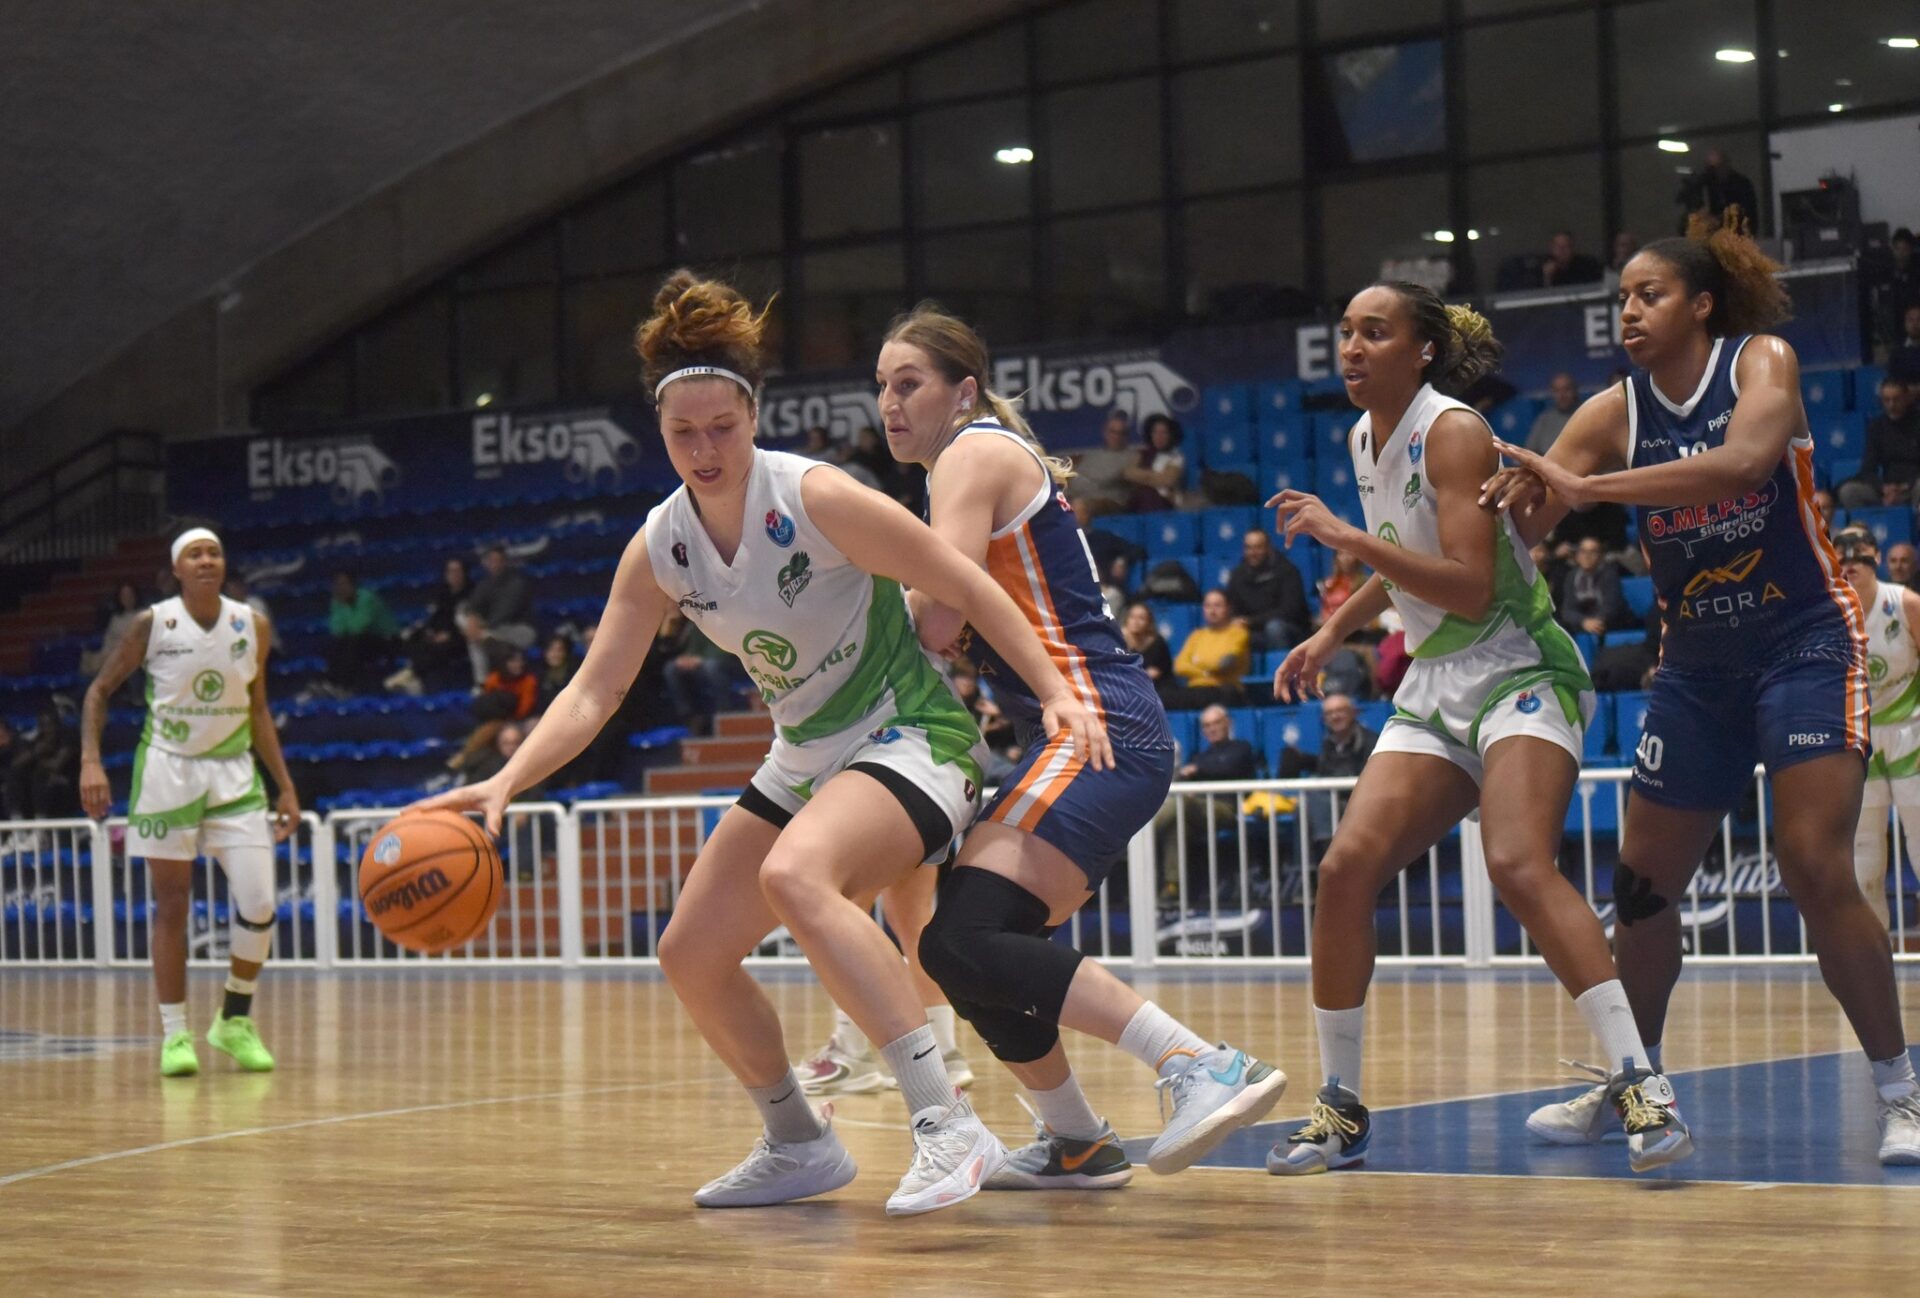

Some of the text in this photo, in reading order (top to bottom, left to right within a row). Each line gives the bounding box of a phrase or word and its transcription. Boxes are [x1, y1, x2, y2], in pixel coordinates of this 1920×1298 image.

[994, 357, 1113, 411] Ekso
[757, 388, 829, 438] kso
[249, 438, 337, 487] Ekso
[474, 413, 571, 464] Ekso
[1680, 582, 1786, 619] AFORA
[139, 817, 168, 839] 00
